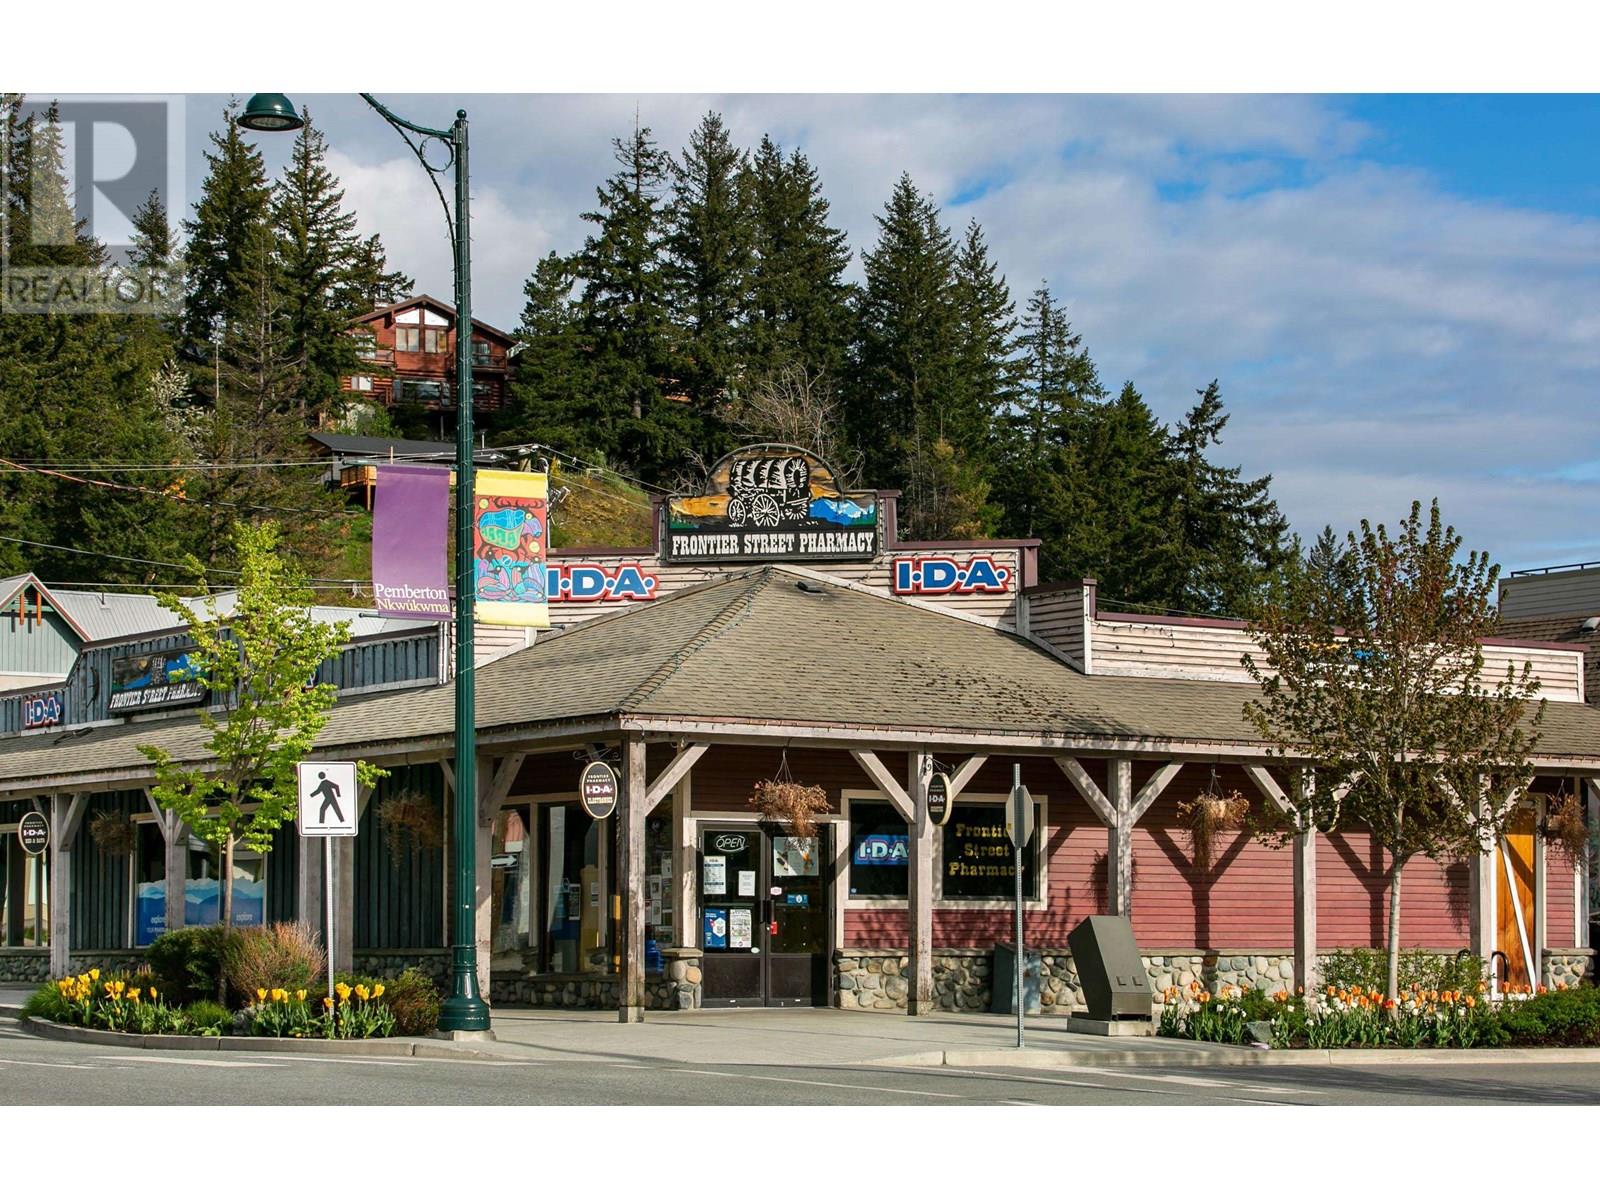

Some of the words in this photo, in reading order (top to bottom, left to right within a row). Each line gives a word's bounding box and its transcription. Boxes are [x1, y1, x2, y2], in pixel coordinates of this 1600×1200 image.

[671, 533, 740, 556] FRONTIER
[743, 532, 795, 555] STREET
[799, 531, 875, 553] PHARMACY
[374, 583, 448, 600] Pemberton
[109, 690, 142, 709] FRONTIER
[141, 686, 169, 704] STREET
[715, 836, 746, 849] OPEN
[963, 842, 1010, 857] Street
[948, 862, 1025, 876] Pharmac
